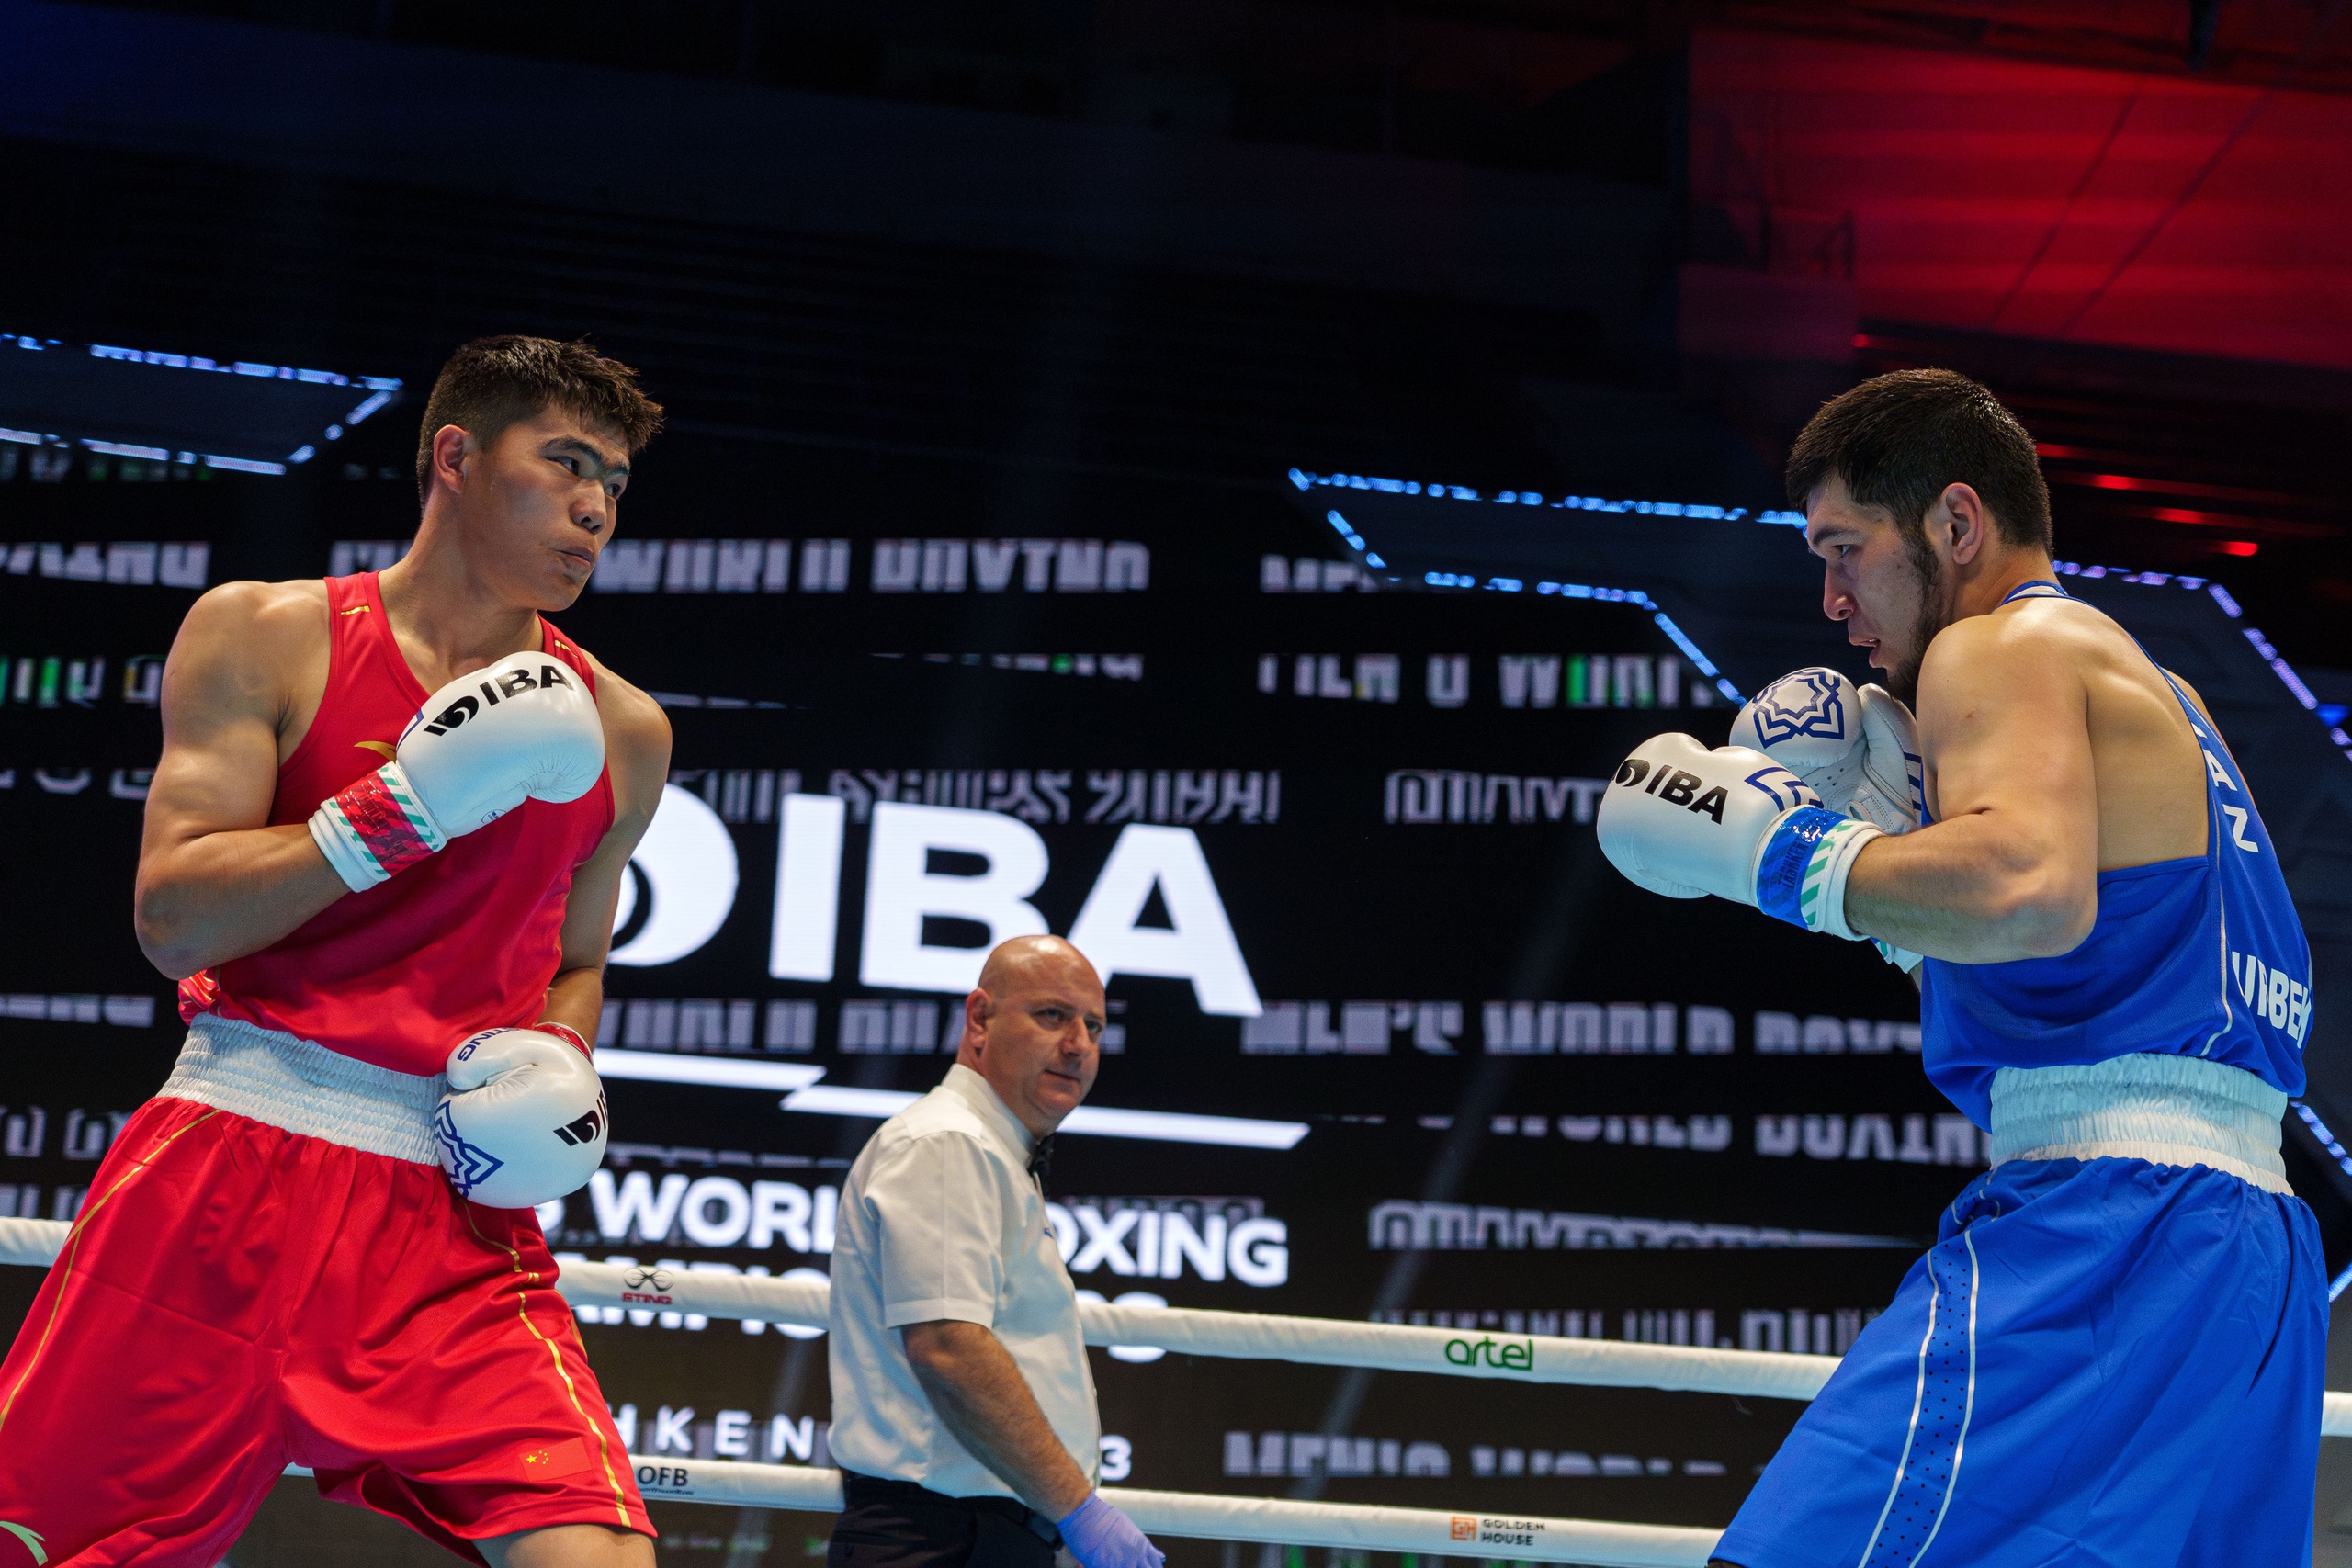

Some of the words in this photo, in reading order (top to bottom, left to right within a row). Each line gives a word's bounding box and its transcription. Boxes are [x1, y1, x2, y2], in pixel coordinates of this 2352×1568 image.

[480, 665, 575, 707] IBA
[1645, 764, 1728, 825] IBA
[769, 792, 1264, 1018] IBA
[587, 1168, 838, 1254] WORL
[1445, 1336, 1533, 1371] artel
[638, 1466, 688, 1486] OFB
[1481, 1532, 1534, 1546] HOUSE
[1483, 1518, 1545, 1530] GOLDEN
